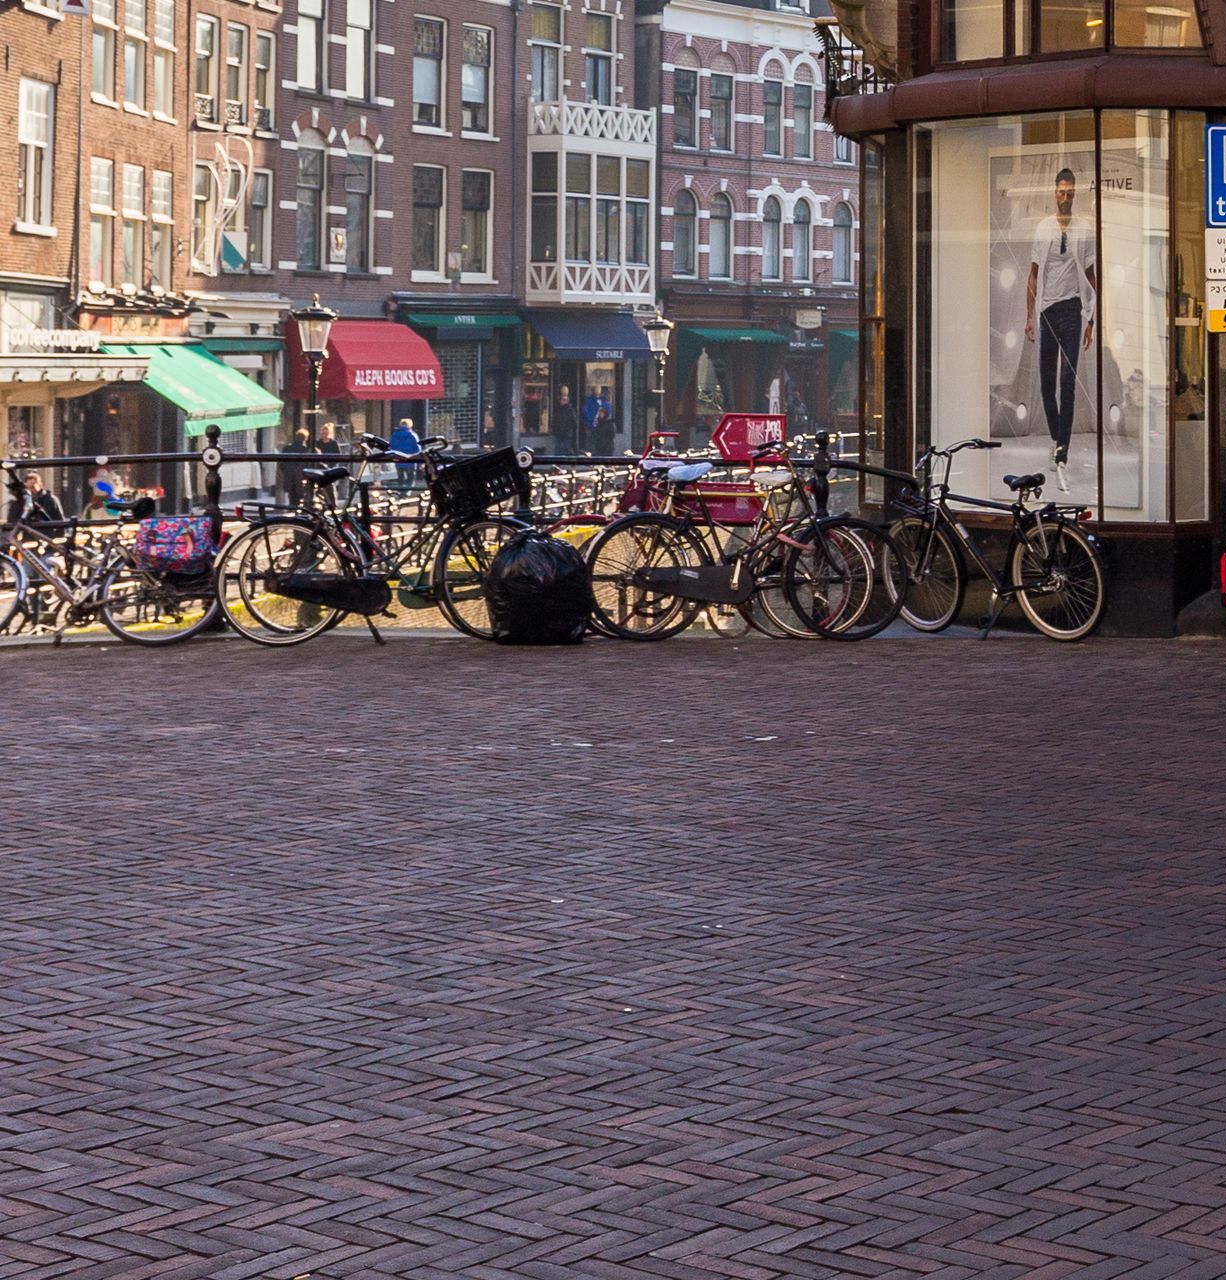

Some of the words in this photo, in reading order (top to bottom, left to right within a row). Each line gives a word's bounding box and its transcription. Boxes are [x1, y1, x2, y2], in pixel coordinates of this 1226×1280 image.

[9, 324, 101, 352] coffeecompany
[355, 369, 384, 386] ALEPH
[384, 369, 415, 386] BOOKS
[415, 369, 436, 386] CD'S
